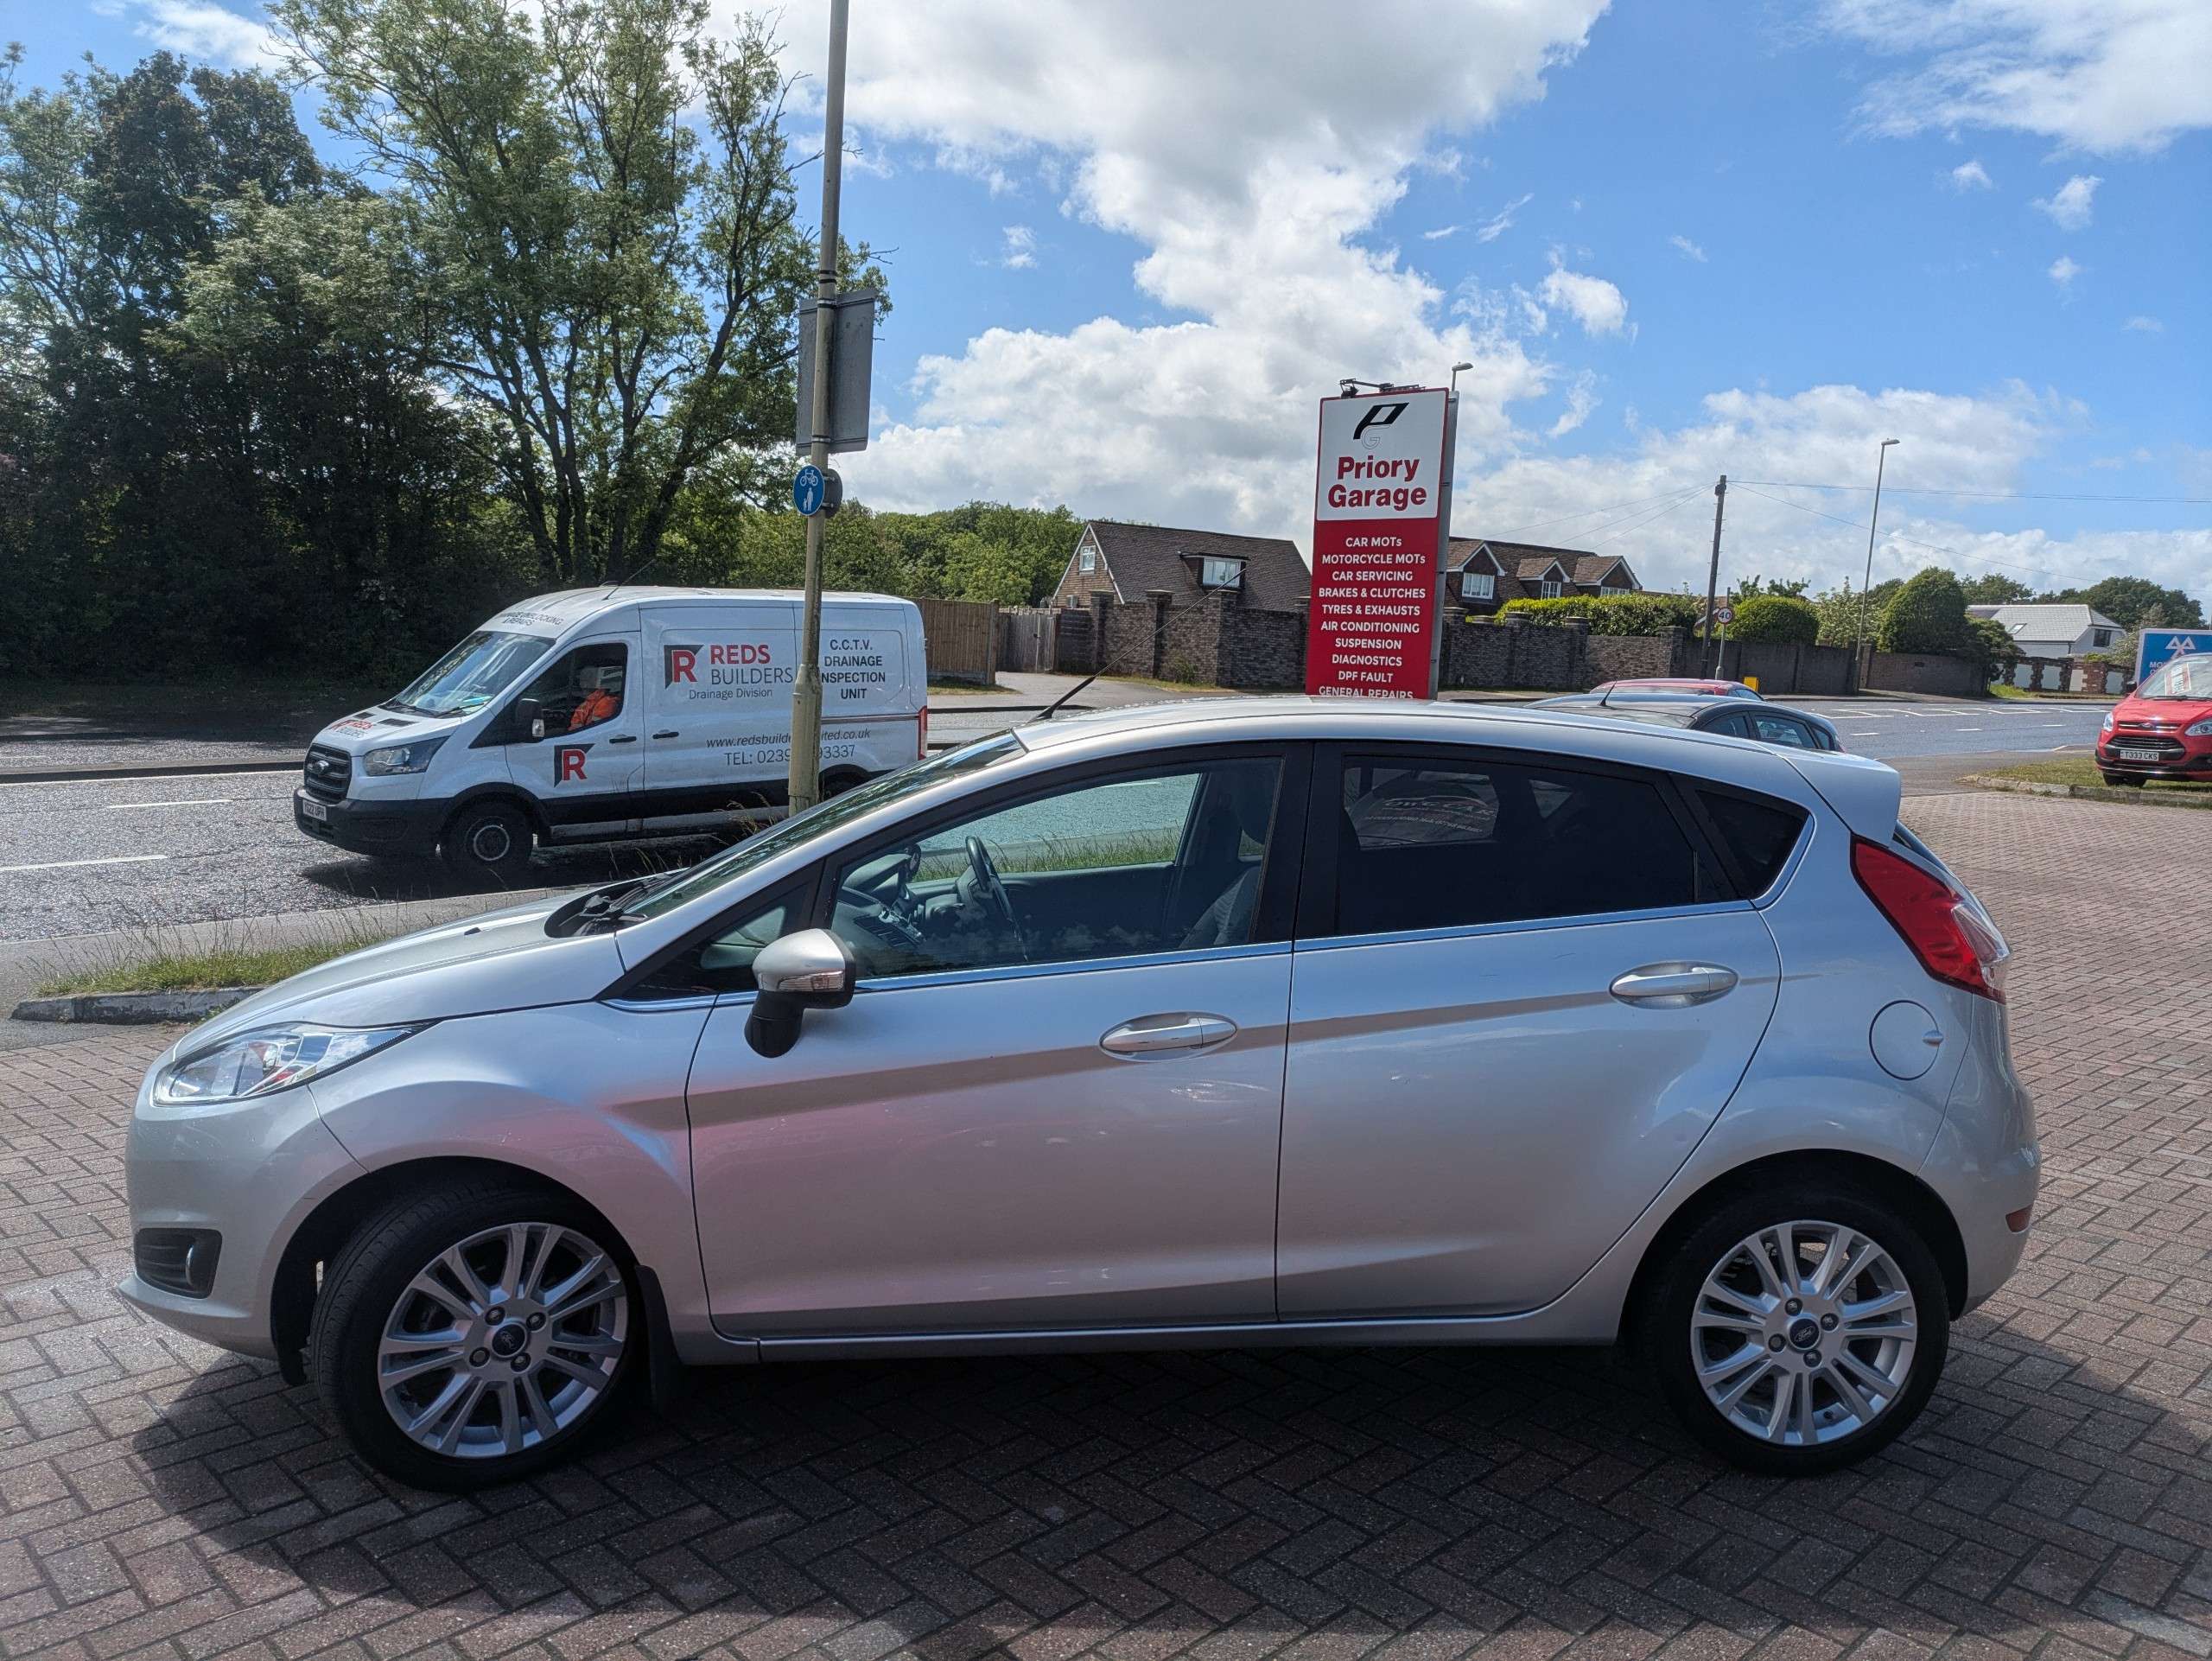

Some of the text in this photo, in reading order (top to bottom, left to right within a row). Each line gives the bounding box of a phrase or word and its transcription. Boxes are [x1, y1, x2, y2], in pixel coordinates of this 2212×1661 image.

[1337, 455, 1420, 482] Priory
[1327, 484, 1427, 512] Garage
[1345, 537, 1402, 548] CAR MOTs
[1322, 554, 1426, 564] MOTORCYCLE MOTs
[1332, 571, 1413, 582] CAR SERVICING
[1319, 588, 1426, 599] BRAKES & CLUTCHES
[1322, 604, 1421, 616] TYRES & EXHAUSTS
[1320, 621, 1420, 633] AIR CONDITIONING
[830, 639, 873, 651] C.C.T.V.
[1335, 638, 1402, 649] SUSPENSION
[710, 644, 771, 665] REDS
[1332, 654, 1402, 666] DIAGNOSTICS
[672, 649, 698, 683] R
[824, 656, 883, 667] DRAINAGE
[711, 667, 793, 685] BUILDERS
[821, 671, 886, 684] NSPECTION
[1338, 671, 1394, 683] DPF FAULT
[689, 688, 772, 701] Drainage Division
[841, 688, 868, 699] UNIT
[563, 749, 588, 781] R
[724, 753, 753, 766] TEL:
